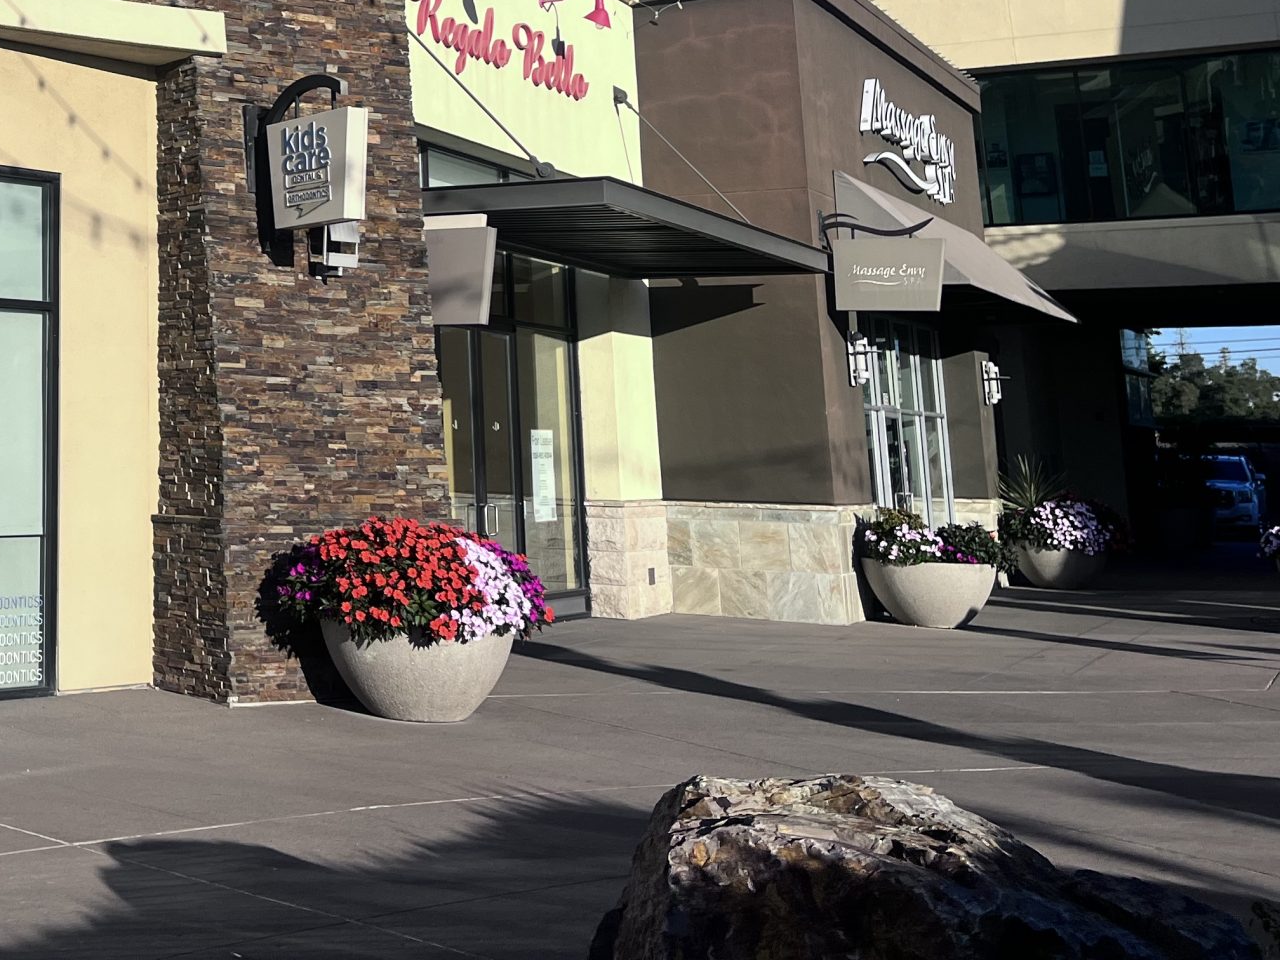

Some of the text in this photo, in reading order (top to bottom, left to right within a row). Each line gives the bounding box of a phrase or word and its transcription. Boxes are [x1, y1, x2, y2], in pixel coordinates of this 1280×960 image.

[281, 121, 328, 156] kids
[860, 79, 956, 180] Massage Envy
[282, 146, 332, 175] care
[291, 172, 316, 183] DENTAL
[848, 264, 925, 278] Massage Envy
